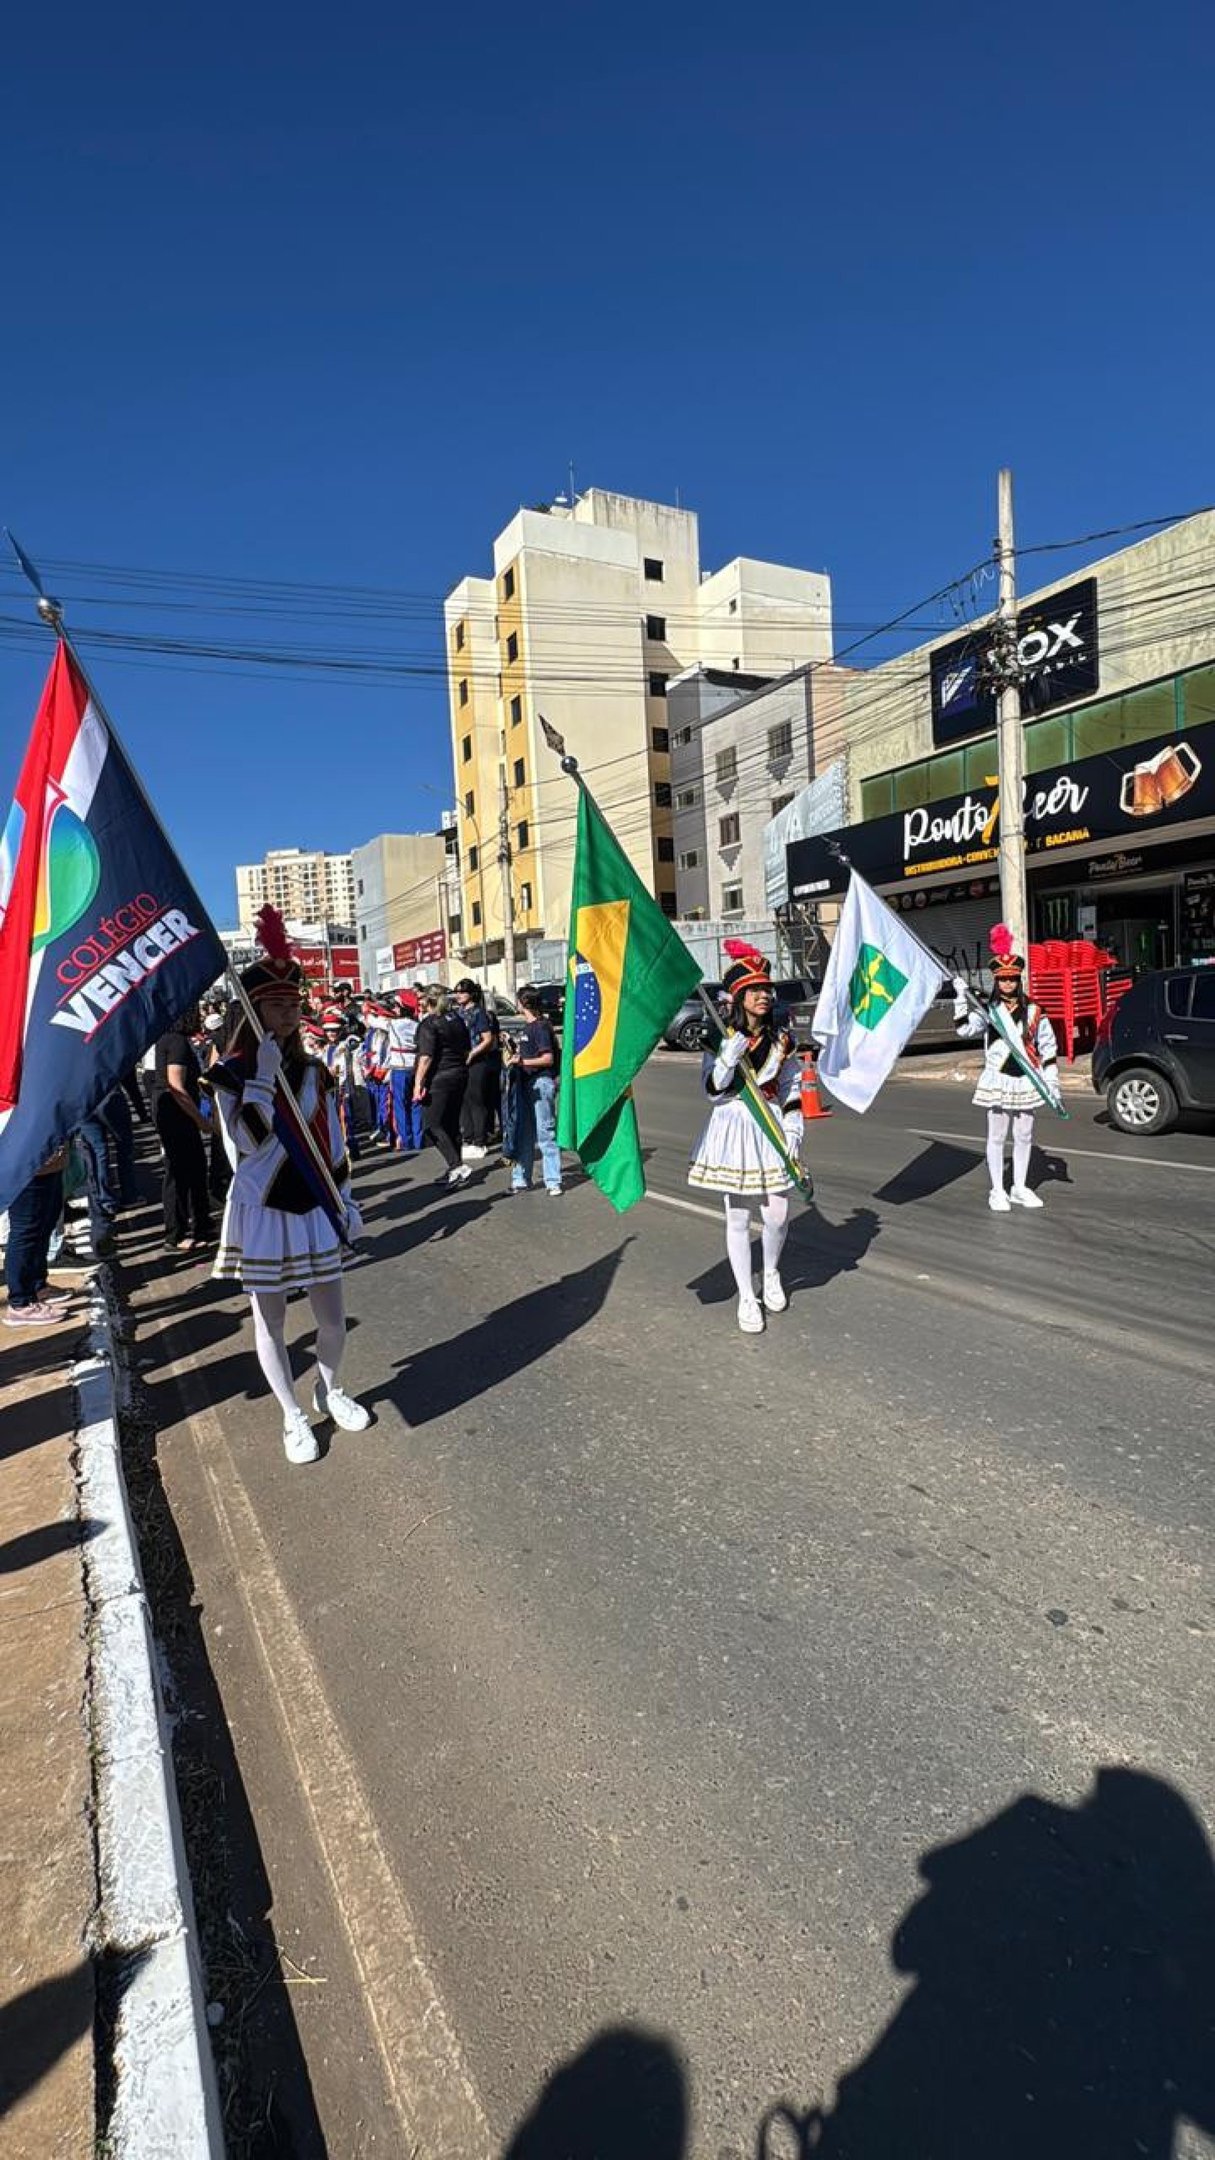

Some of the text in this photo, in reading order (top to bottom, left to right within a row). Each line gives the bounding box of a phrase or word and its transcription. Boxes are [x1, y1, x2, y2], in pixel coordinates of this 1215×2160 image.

[988, 611, 1085, 677] OX
[903, 796, 989, 861] Ponto
[1021, 776, 1090, 820] eer
[49, 909, 200, 1034] VENCER
[56, 893, 159, 985] COLÉGIO
